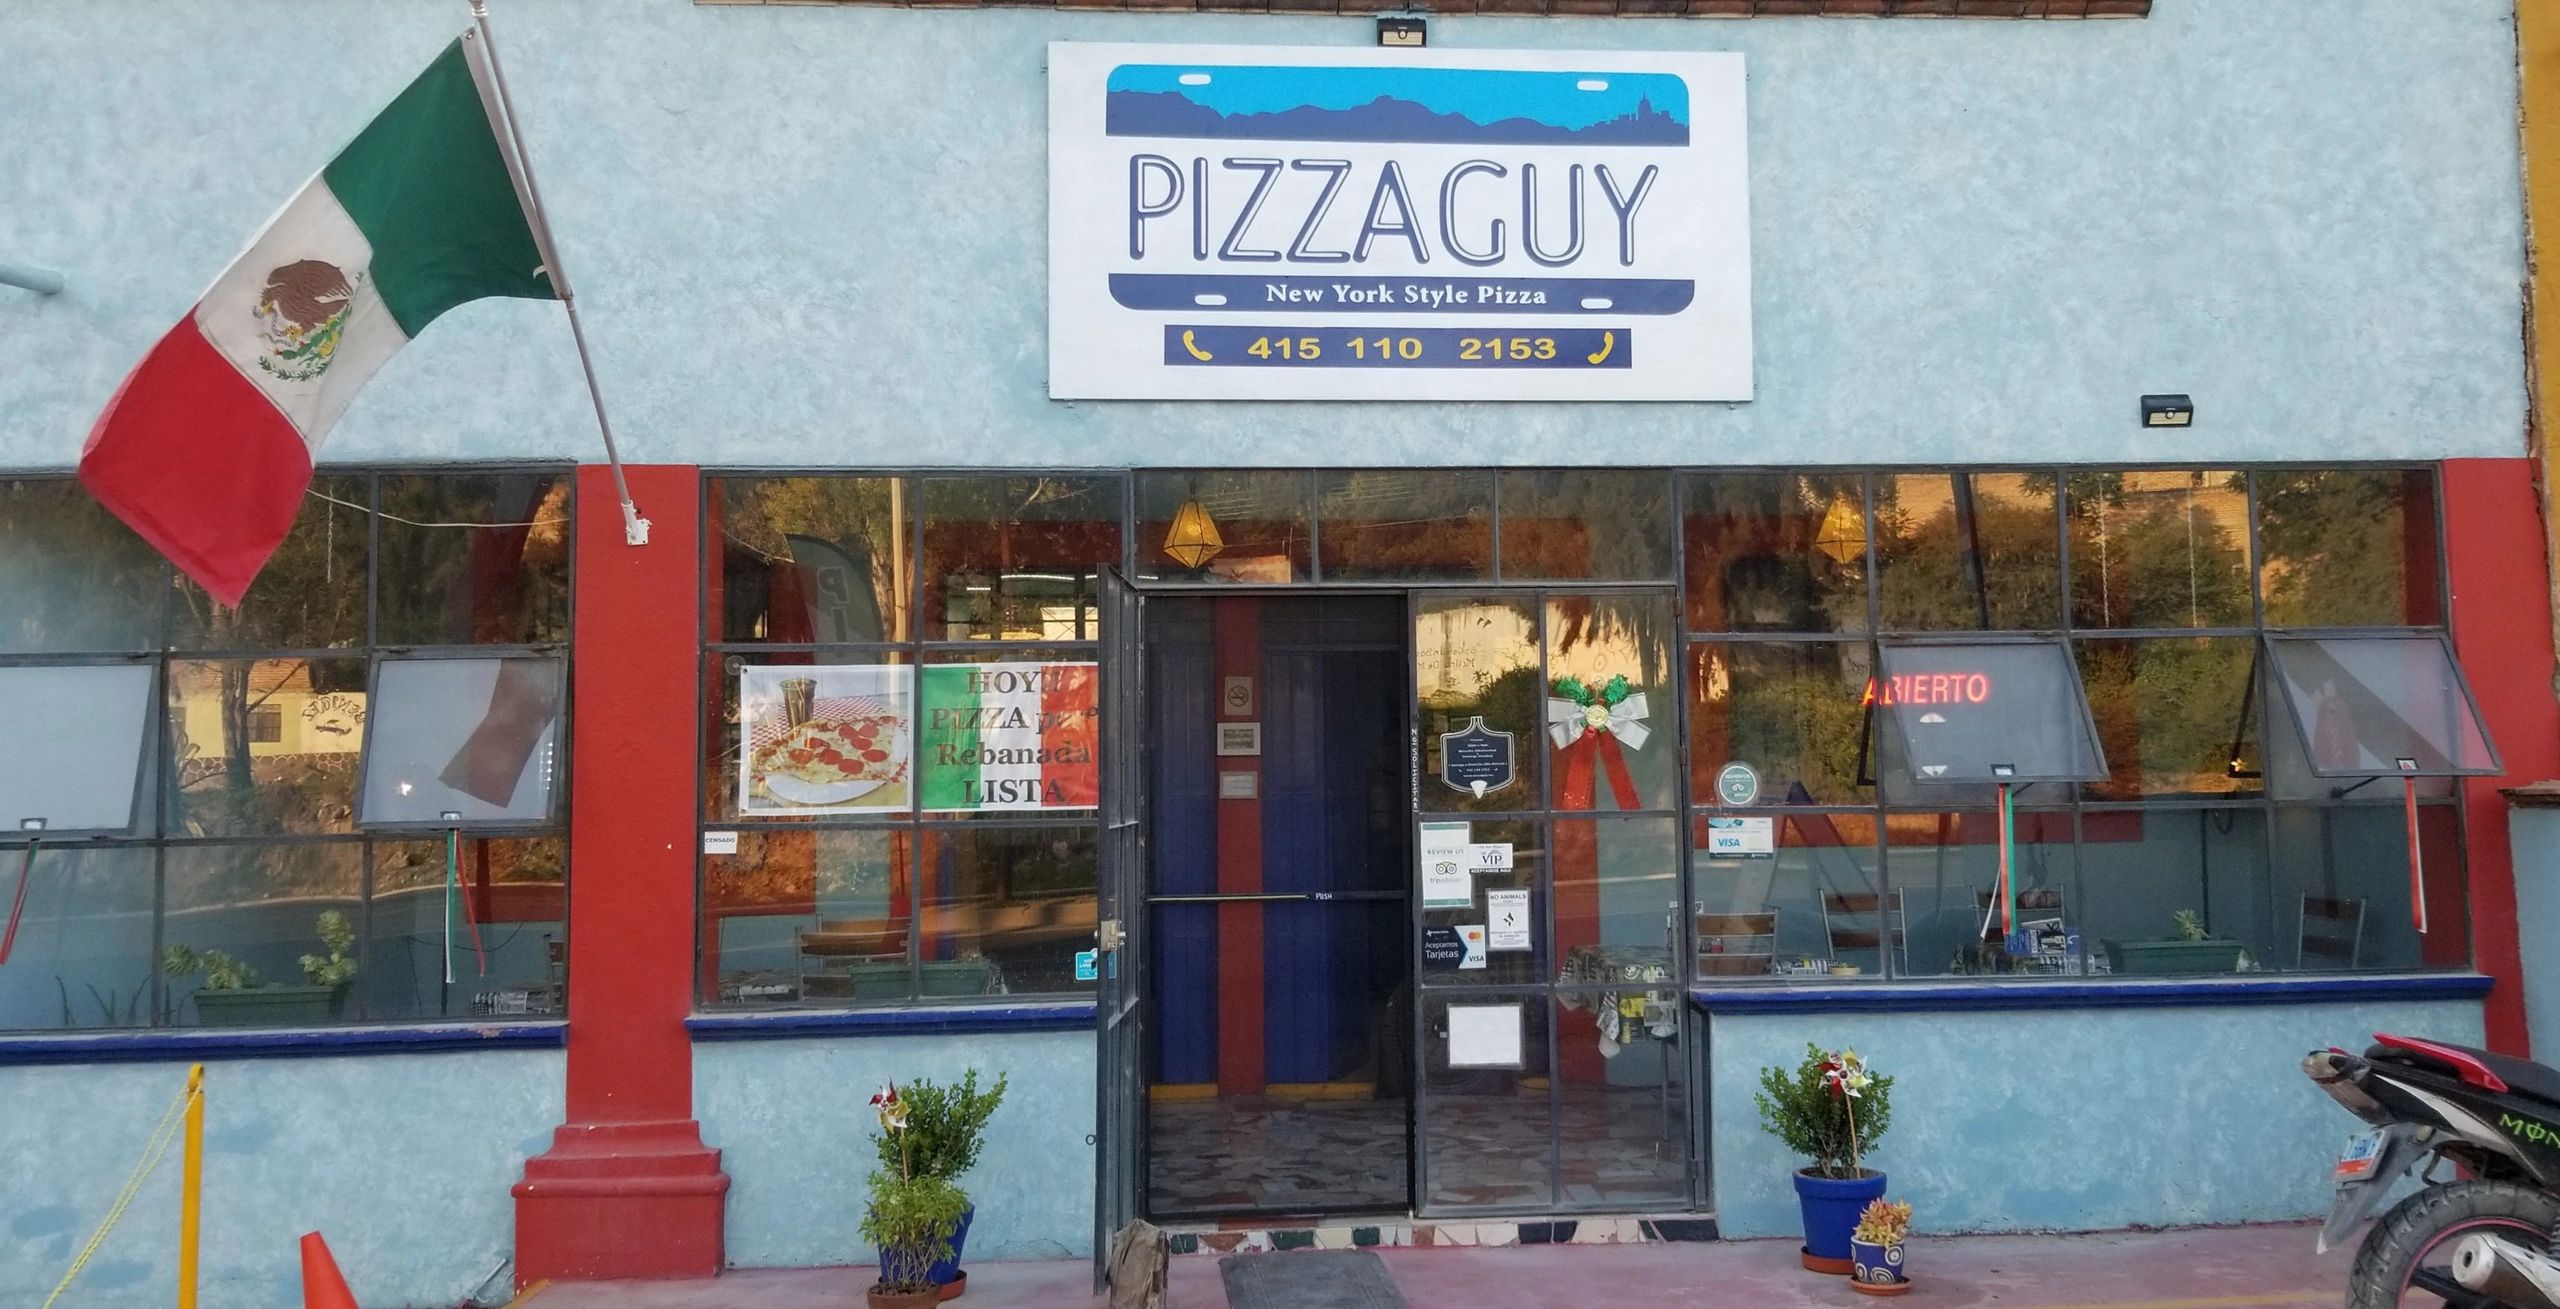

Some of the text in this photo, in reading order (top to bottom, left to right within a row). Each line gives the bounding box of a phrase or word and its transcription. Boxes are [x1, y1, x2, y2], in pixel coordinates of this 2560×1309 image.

[1129, 153, 1659, 266] PIZZAGUY
[1266, 284, 1548, 310] New York Style Pizza
[1247, 338, 1557, 361] 415 110 2153
[929, 708, 1030, 731] PIZZA
[936, 740, 1090, 766] Rebanada
[963, 778, 1067, 804] LISTA
[1718, 838, 1740, 847] VISA
[1482, 855, 1503, 865] VIP
[1315, 892, 1332, 900] PUSH
[1425, 941, 1459, 950] Aceptamos
[1425, 949, 1460, 961] Tarjetas
[1468, 954, 1485, 962] VISA
